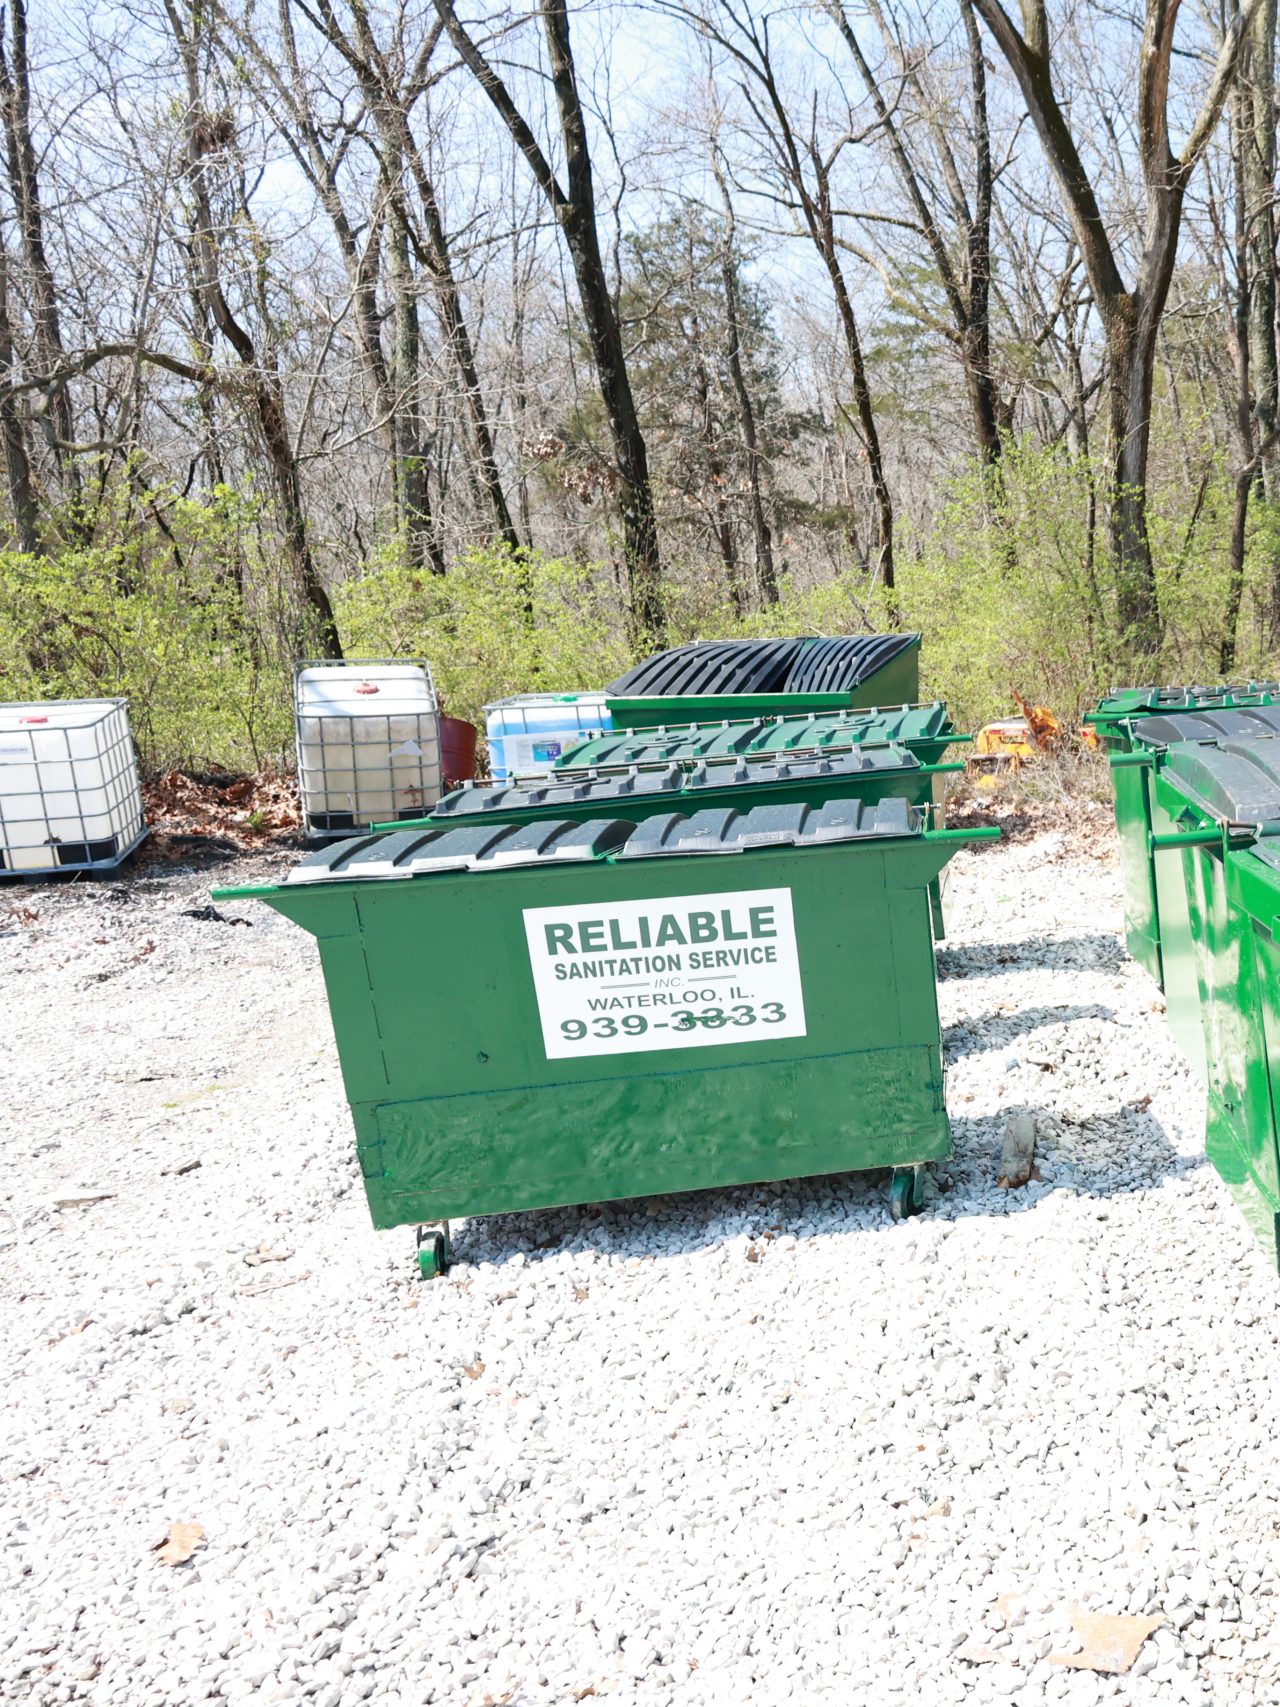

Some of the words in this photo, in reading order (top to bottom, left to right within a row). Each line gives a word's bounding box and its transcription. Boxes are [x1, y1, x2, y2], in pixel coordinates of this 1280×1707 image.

[544, 906, 777, 955] RELIABLE
[554, 953, 682, 980] SANITATION
[689, 945, 777, 970] SERVICE
[587, 988, 723, 1011] WATERLOO,
[730, 986, 755, 1000] IL.
[654, 977, 685, 989] INC.
[560, 1002, 787, 1041] 939-3333
